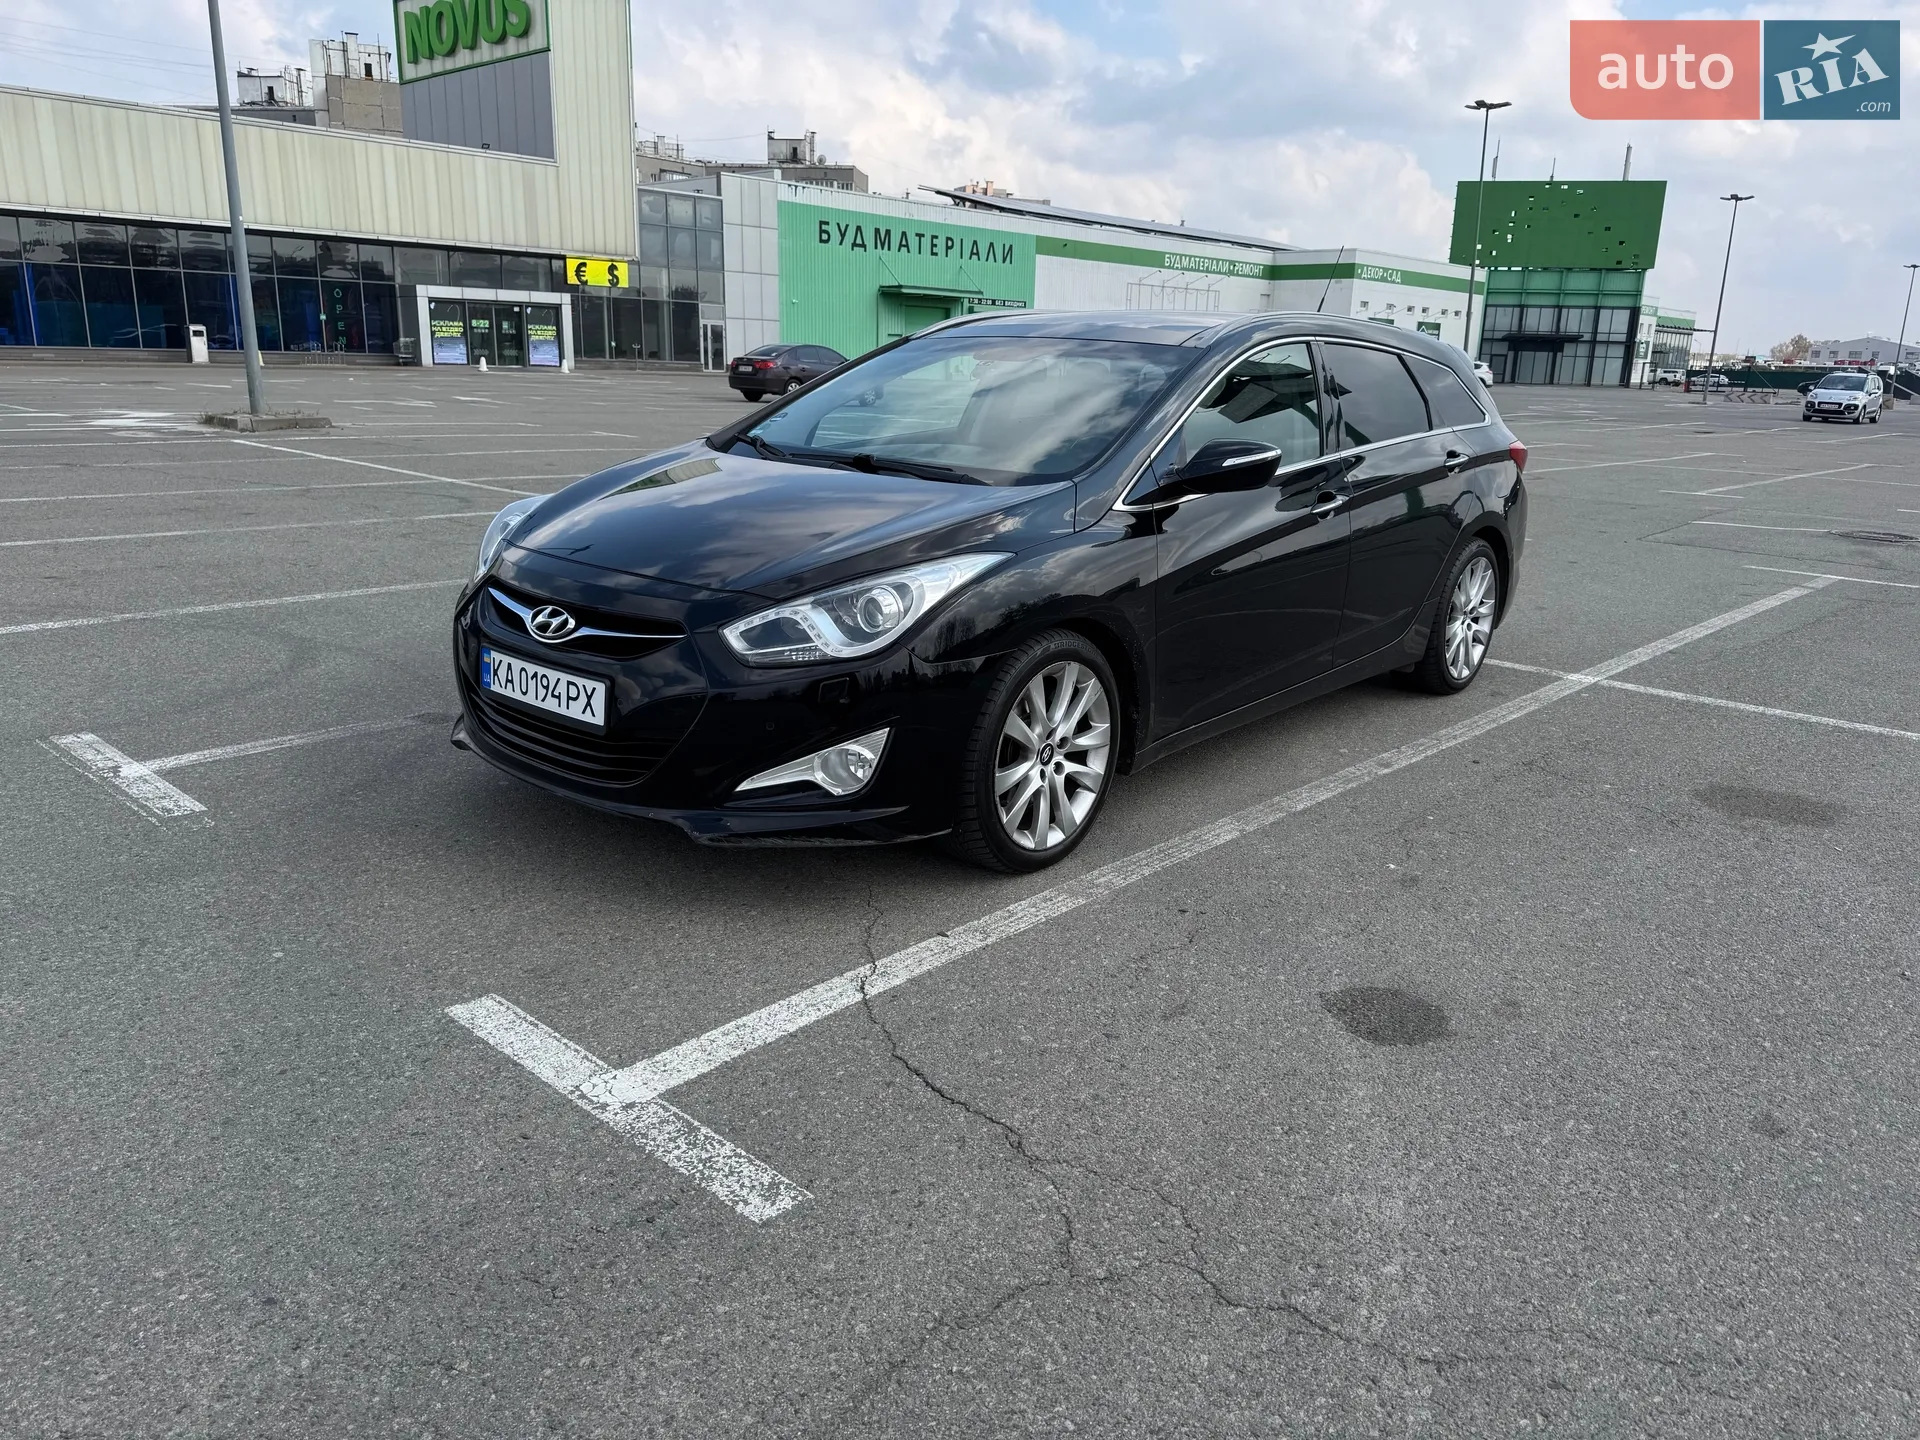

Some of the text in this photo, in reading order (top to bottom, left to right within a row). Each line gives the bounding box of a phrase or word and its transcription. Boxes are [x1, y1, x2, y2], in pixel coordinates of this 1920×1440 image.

[404, 0, 531, 64] NOVUS
[819, 220, 1014, 265] БУДМАТЕРІАЛИ
[607, 262, 620, 287] $
[1164, 254, 1264, 277] БУДМАТЕРІАЛИ РЕМОНТ
[1361, 266, 1402, 284] ДЕКОР САД
[333, 288, 347, 345] OPEN
[483, 672, 491, 683] UA
[492, 656, 597, 718] KA0194PX
